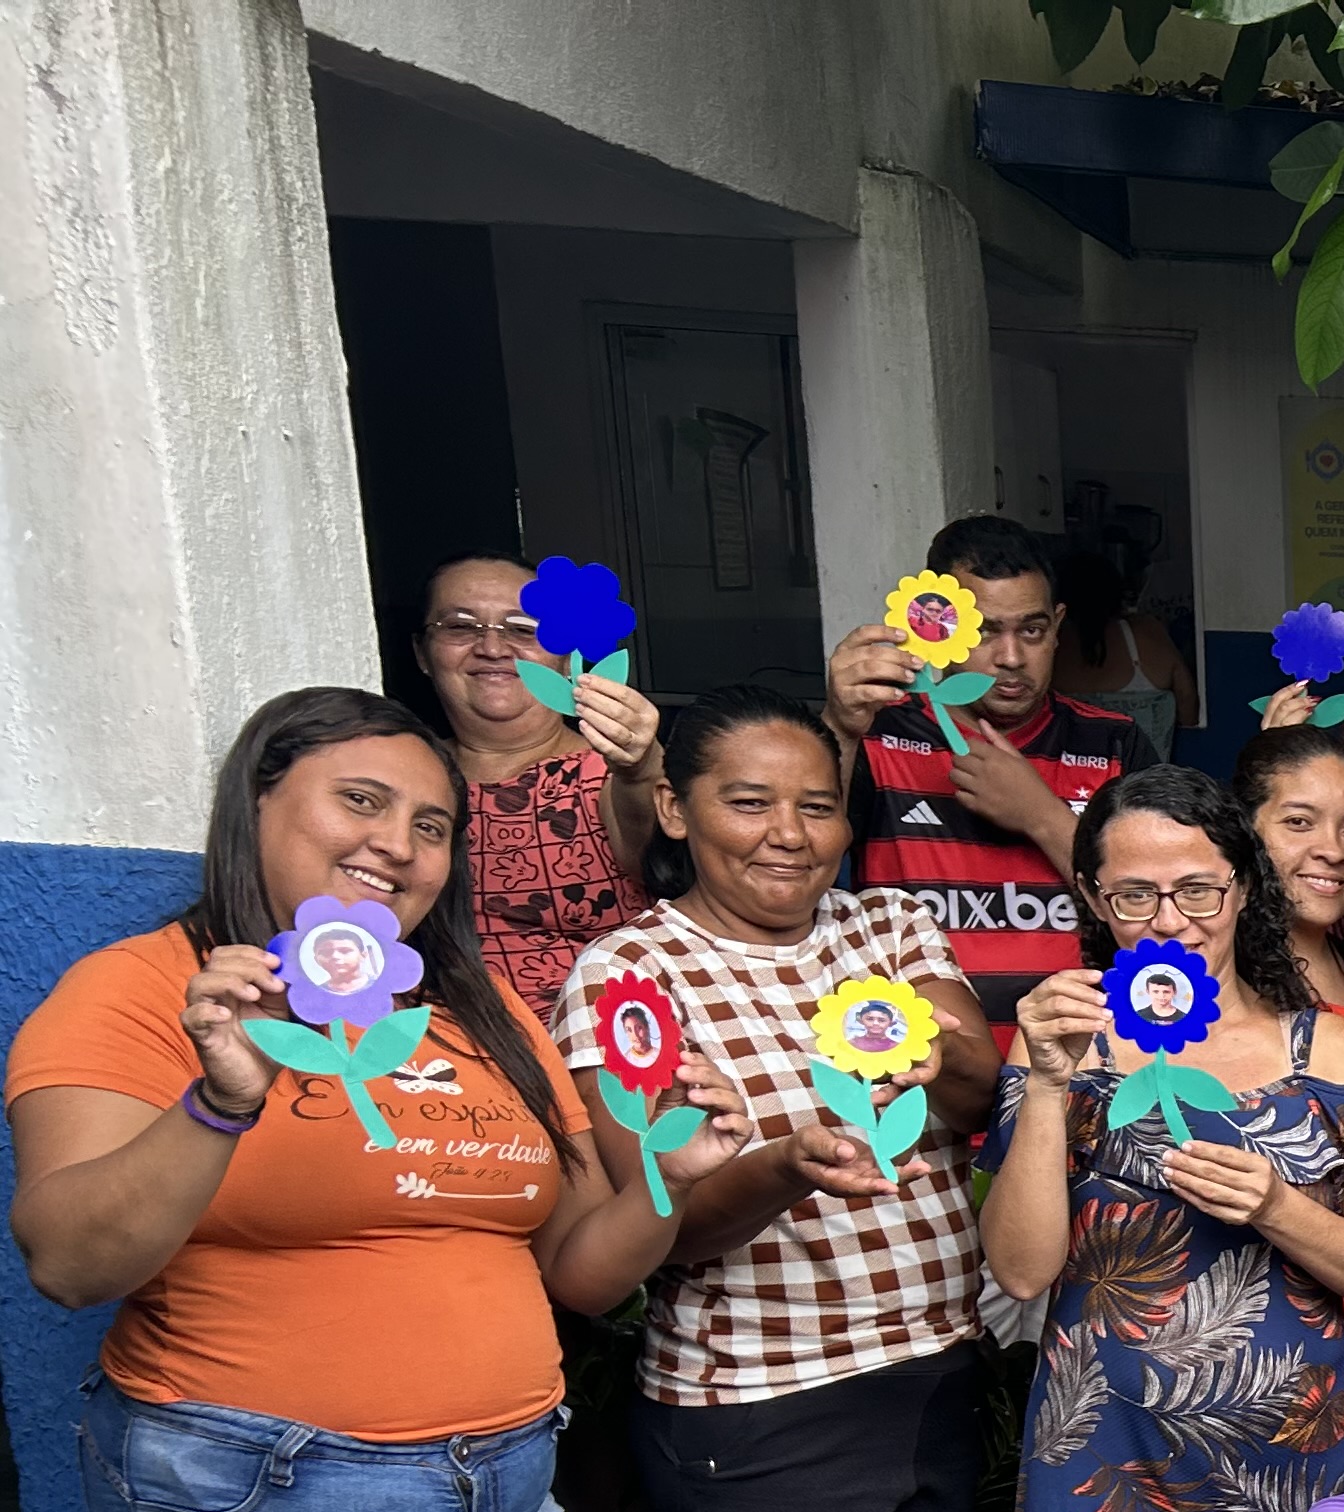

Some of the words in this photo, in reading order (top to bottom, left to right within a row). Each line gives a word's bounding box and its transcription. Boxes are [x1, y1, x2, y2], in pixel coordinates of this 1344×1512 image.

[1314, 501, 1324, 511] A
[1304, 526, 1338, 539] QUEM
[899, 739, 932, 756] BRB
[1076, 755, 1109, 770] BRB
[396, 1137, 438, 1156] em
[445, 1134, 551, 1165] verdade
